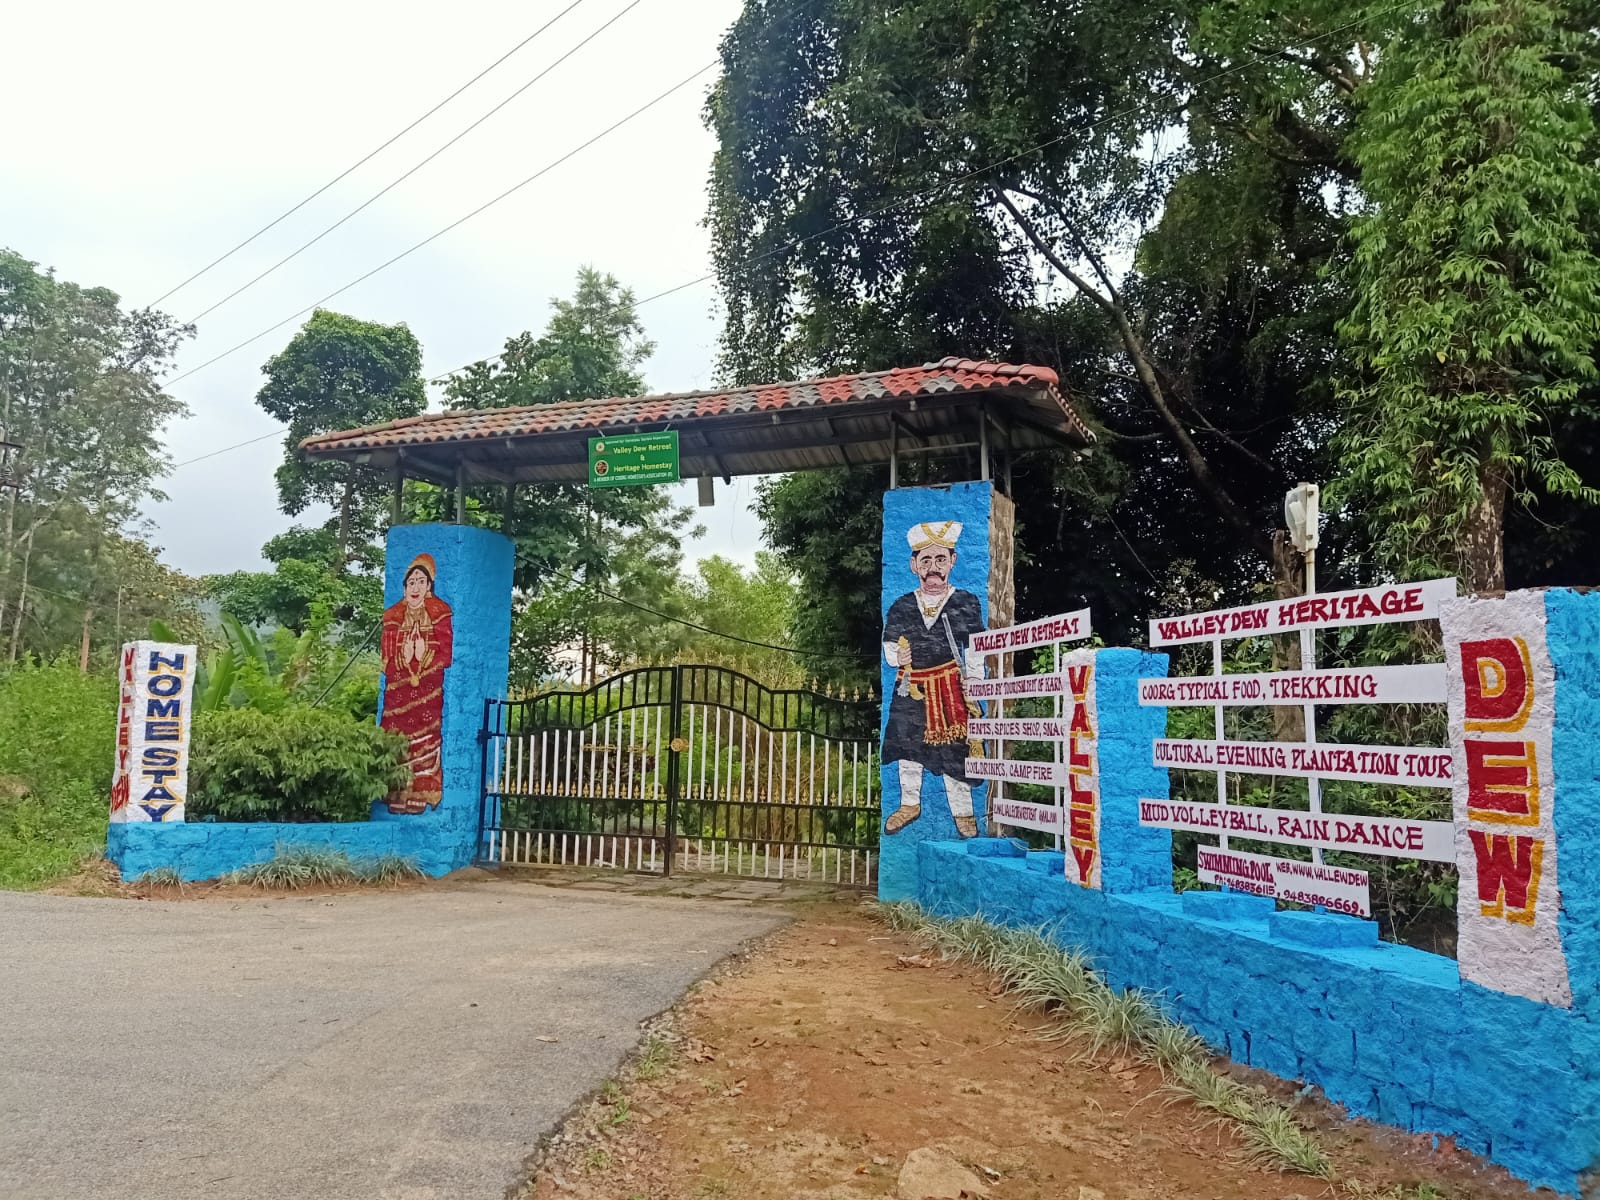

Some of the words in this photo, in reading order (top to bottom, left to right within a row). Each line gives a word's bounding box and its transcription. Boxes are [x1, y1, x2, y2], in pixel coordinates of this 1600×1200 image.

[613, 446, 632, 454] Valley
[648, 443, 672, 451] Retreat
[614, 464, 640, 472] Heritage
[641, 462, 672, 471] Homestay
[1158, 613, 1229, 640] VALLEY
[1230, 608, 1269, 633] DEW
[1278, 587, 1424, 625] HERITAGE
[974, 632, 1009, 652] VALLEY
[1010, 627, 1030, 646] DEW
[1031, 617, 1079, 642] RETREAT
[1142, 683, 1176, 701] COORG
[1177, 677, 1229, 701] TYPICAL
[1232, 678, 1267, 701] FOOD,
[1269, 674, 1378, 699] TREKKING
[118, 648, 135, 772] VALLEY
[994, 722, 1020, 737] SPICES
[1068, 665, 1098, 888] VALLEY
[1155, 743, 1214, 765] CULTURAL
[1216, 745, 1286, 769] EVENING
[1291, 748, 1400, 776] PLANTATION
[1403, 754, 1453, 779] TOUR
[1460, 637, 1544, 927] DEW
[1141, 801, 1169, 822] MUD
[1277, 816, 1330, 841] RAIN
[1334, 820, 1424, 850] DANCE
[1198, 850, 1249, 878] SWIMMING
